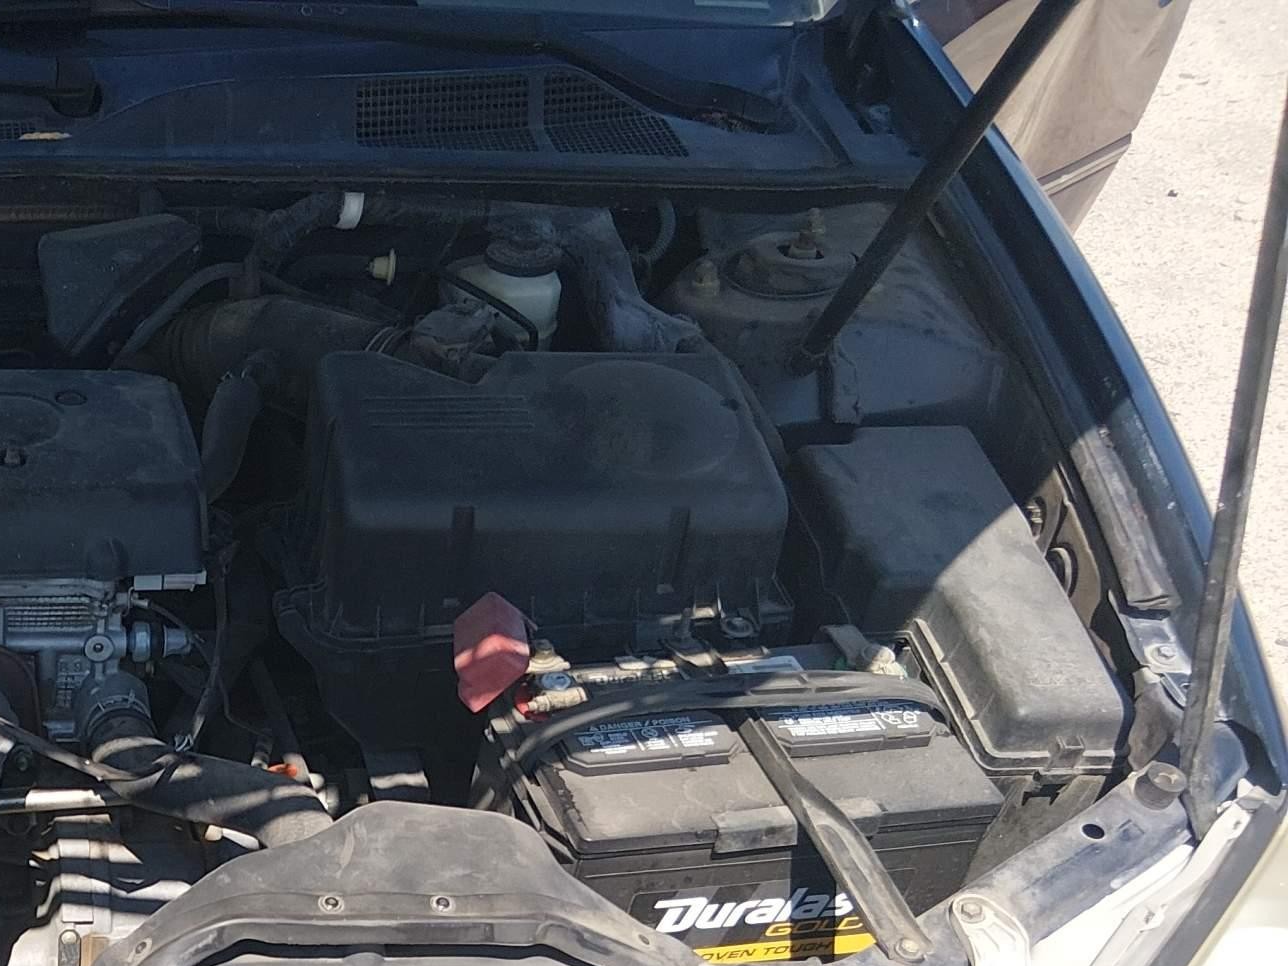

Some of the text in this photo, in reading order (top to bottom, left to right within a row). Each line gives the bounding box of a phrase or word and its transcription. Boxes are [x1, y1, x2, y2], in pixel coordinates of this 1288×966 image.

[599, 721, 642, 731] DANGER
[654, 887, 854, 933] Duralas
[701, 941, 832, 961] OVEN TOUGH
